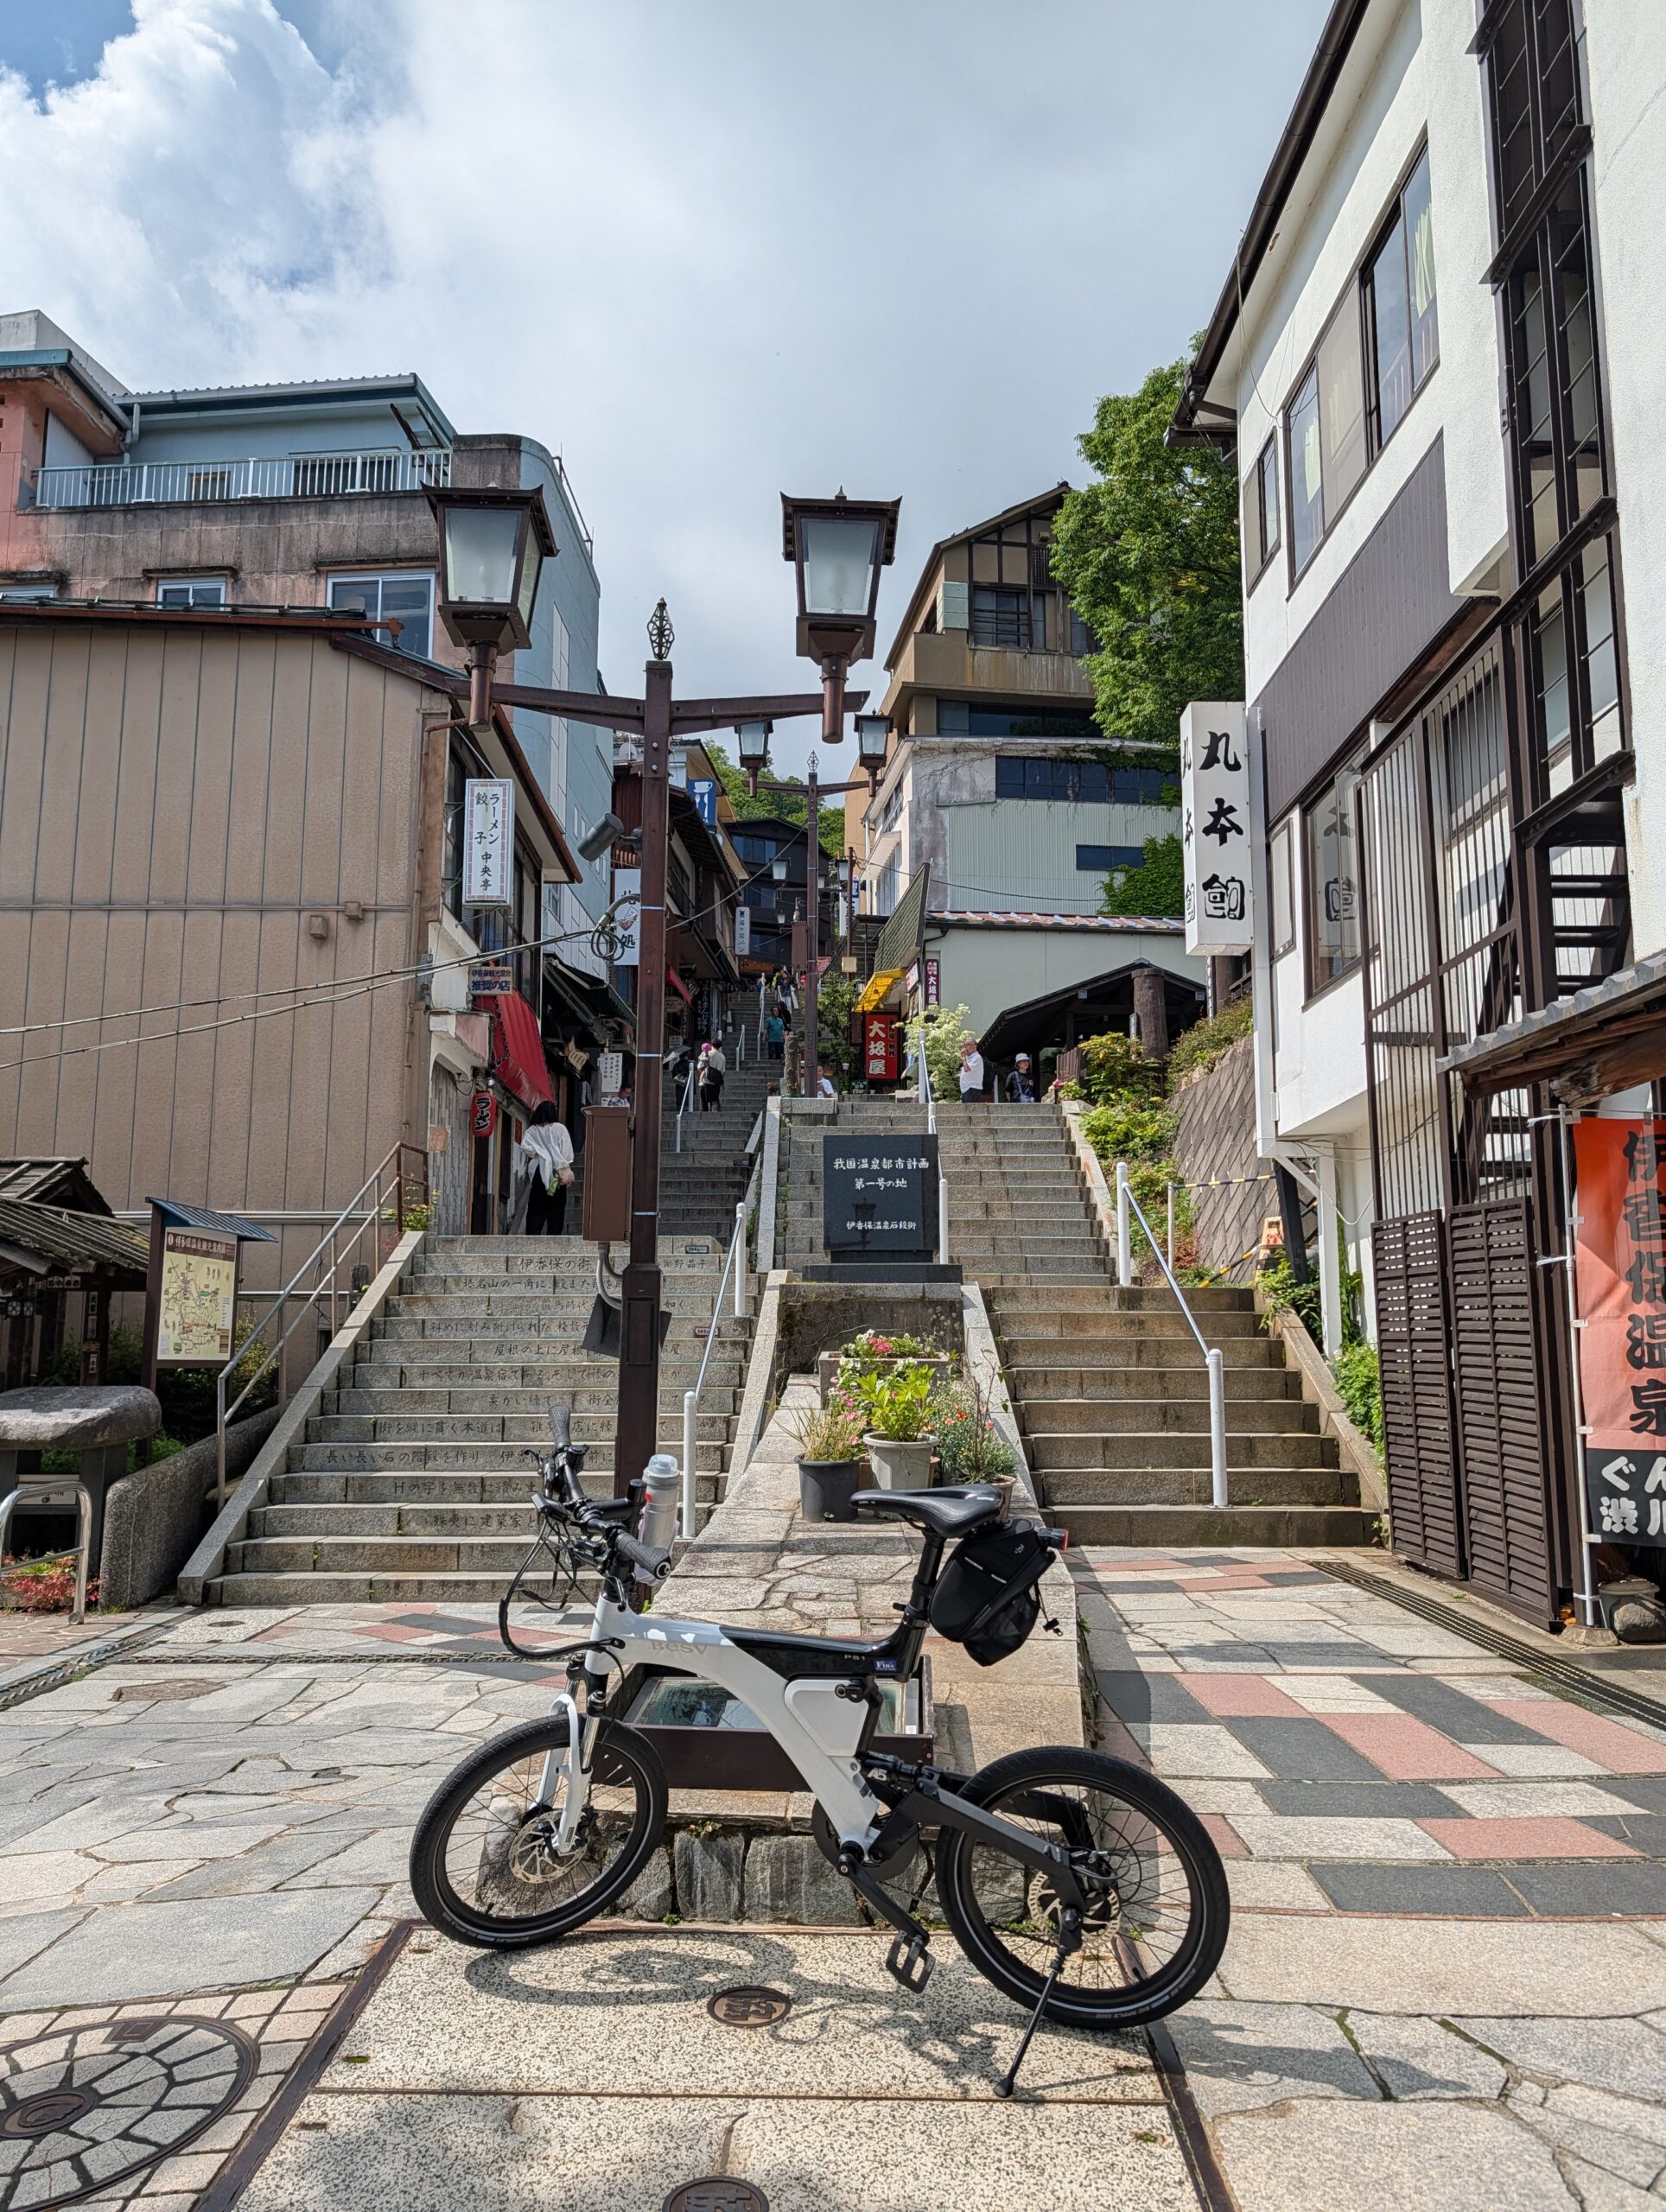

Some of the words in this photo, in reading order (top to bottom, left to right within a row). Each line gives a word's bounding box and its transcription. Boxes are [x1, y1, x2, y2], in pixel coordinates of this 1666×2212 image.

[474, 791, 488, 845] 餃子
[488, 793, 500, 845] ラーメン
[480, 851, 493, 891] 中央亭
[474, 1096, 491, 1131] ラーメン
[833, 1157, 929, 1170] 我国温泉都市計画
[854, 1177, 908, 1191] 第一号の地
[846, 1220, 917, 1230] 伊香保温泉石段街
